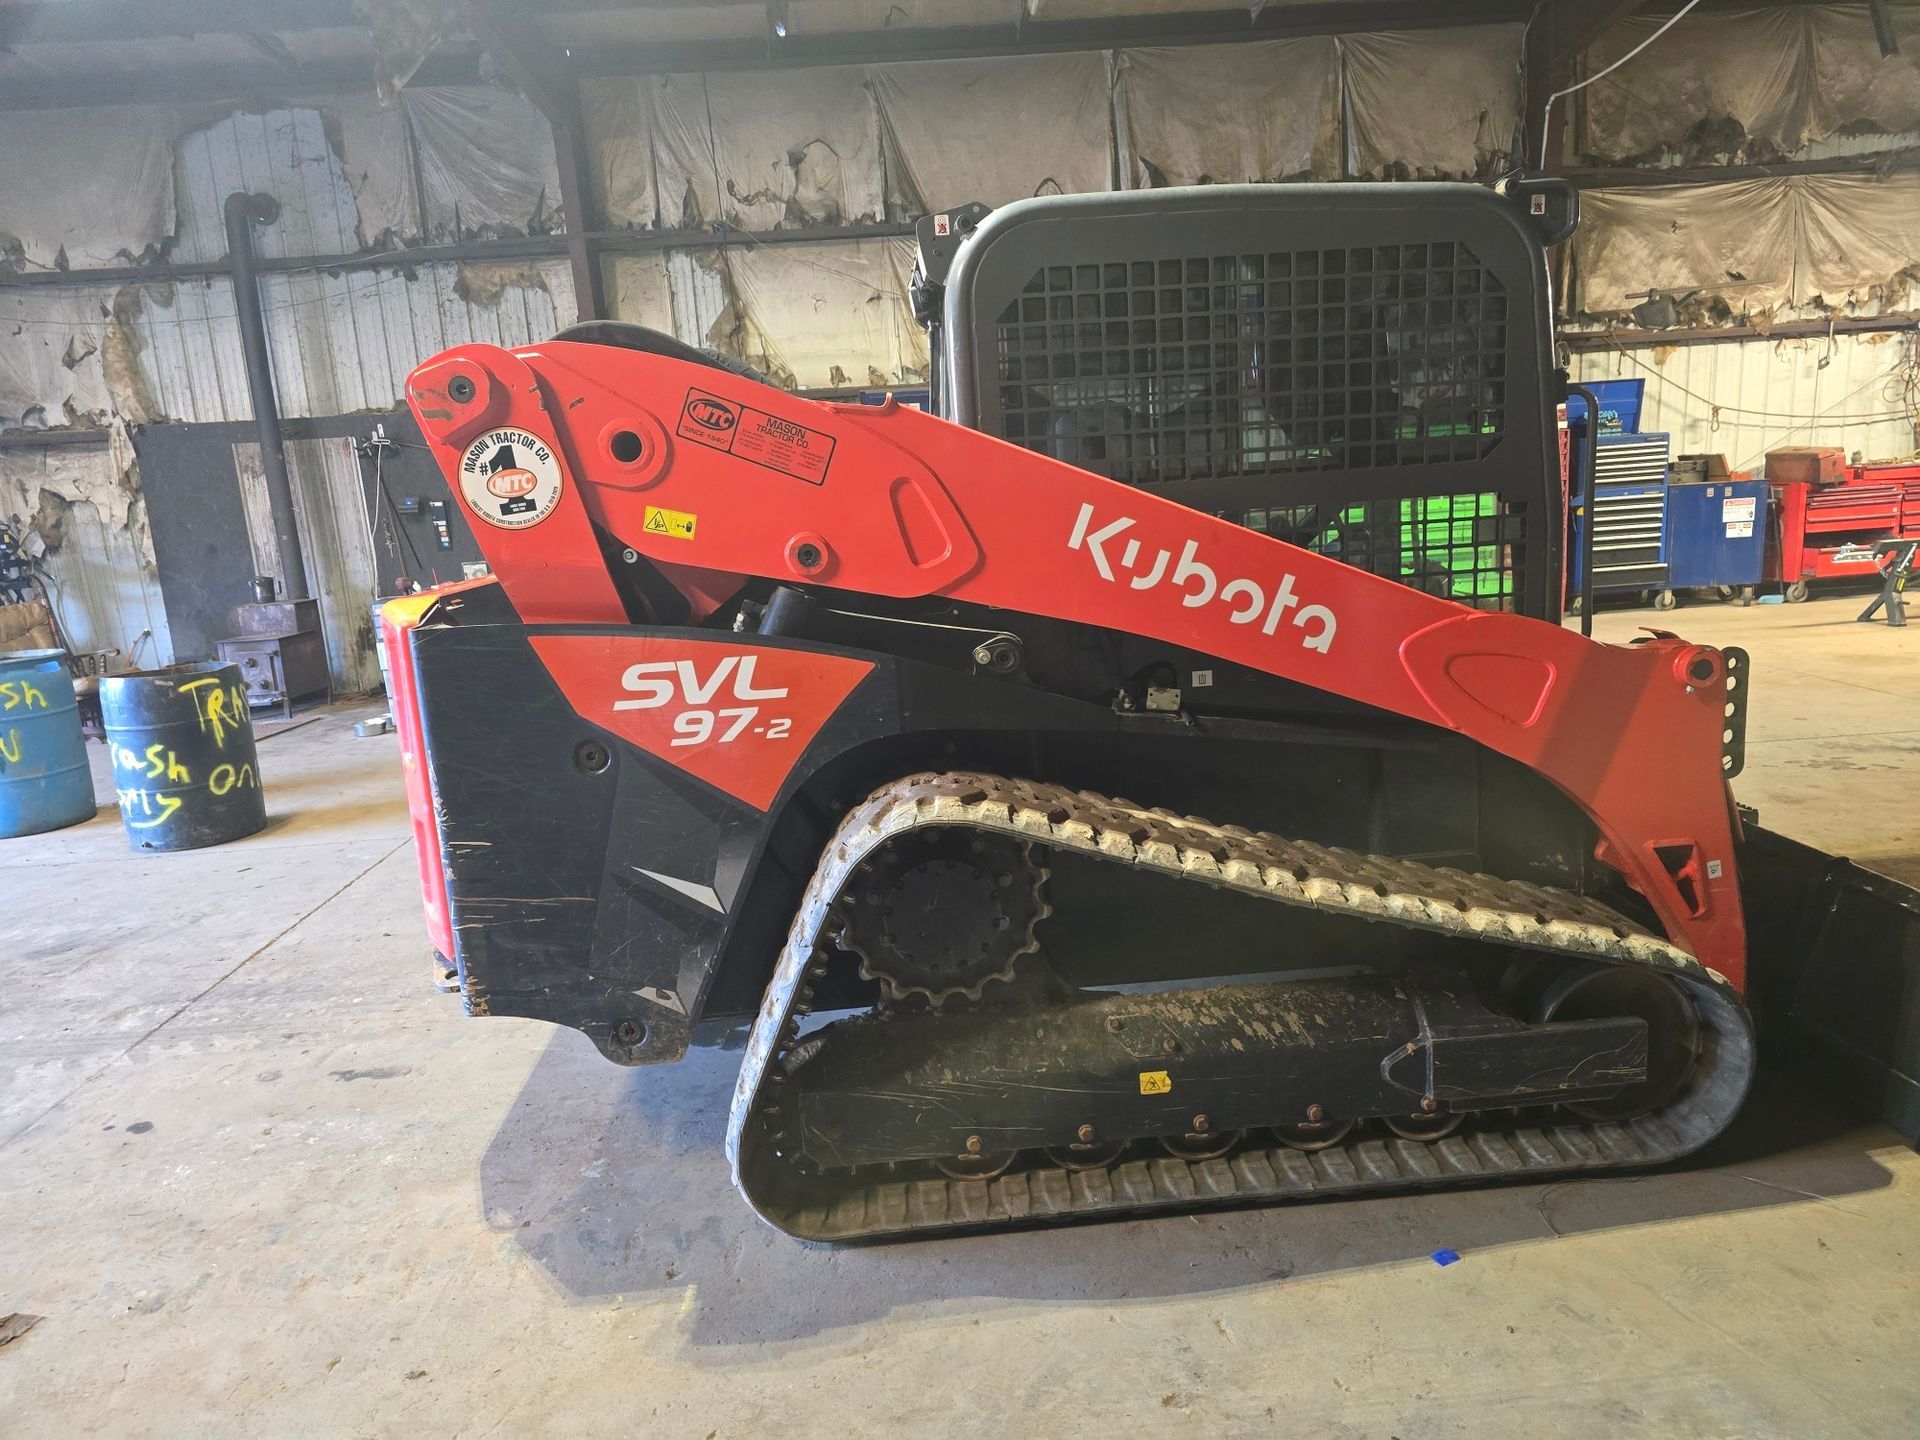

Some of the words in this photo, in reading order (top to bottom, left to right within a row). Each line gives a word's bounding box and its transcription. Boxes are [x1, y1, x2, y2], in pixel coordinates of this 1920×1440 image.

[693, 402, 733, 428] MTC
[766, 417, 806, 439] MASON
[464, 439, 490, 474] MASON
[489, 432, 536, 451] TRACTOR
[535, 446, 549, 465] CO.
[756, 424, 795, 444] TRACTOR
[796, 438, 810, 450] CO.
[494, 473, 534, 493] MTC
[1067, 502, 1338, 655] Kubota
[612, 655, 789, 711] SVL
[670, 706, 792, 747] 97-2
